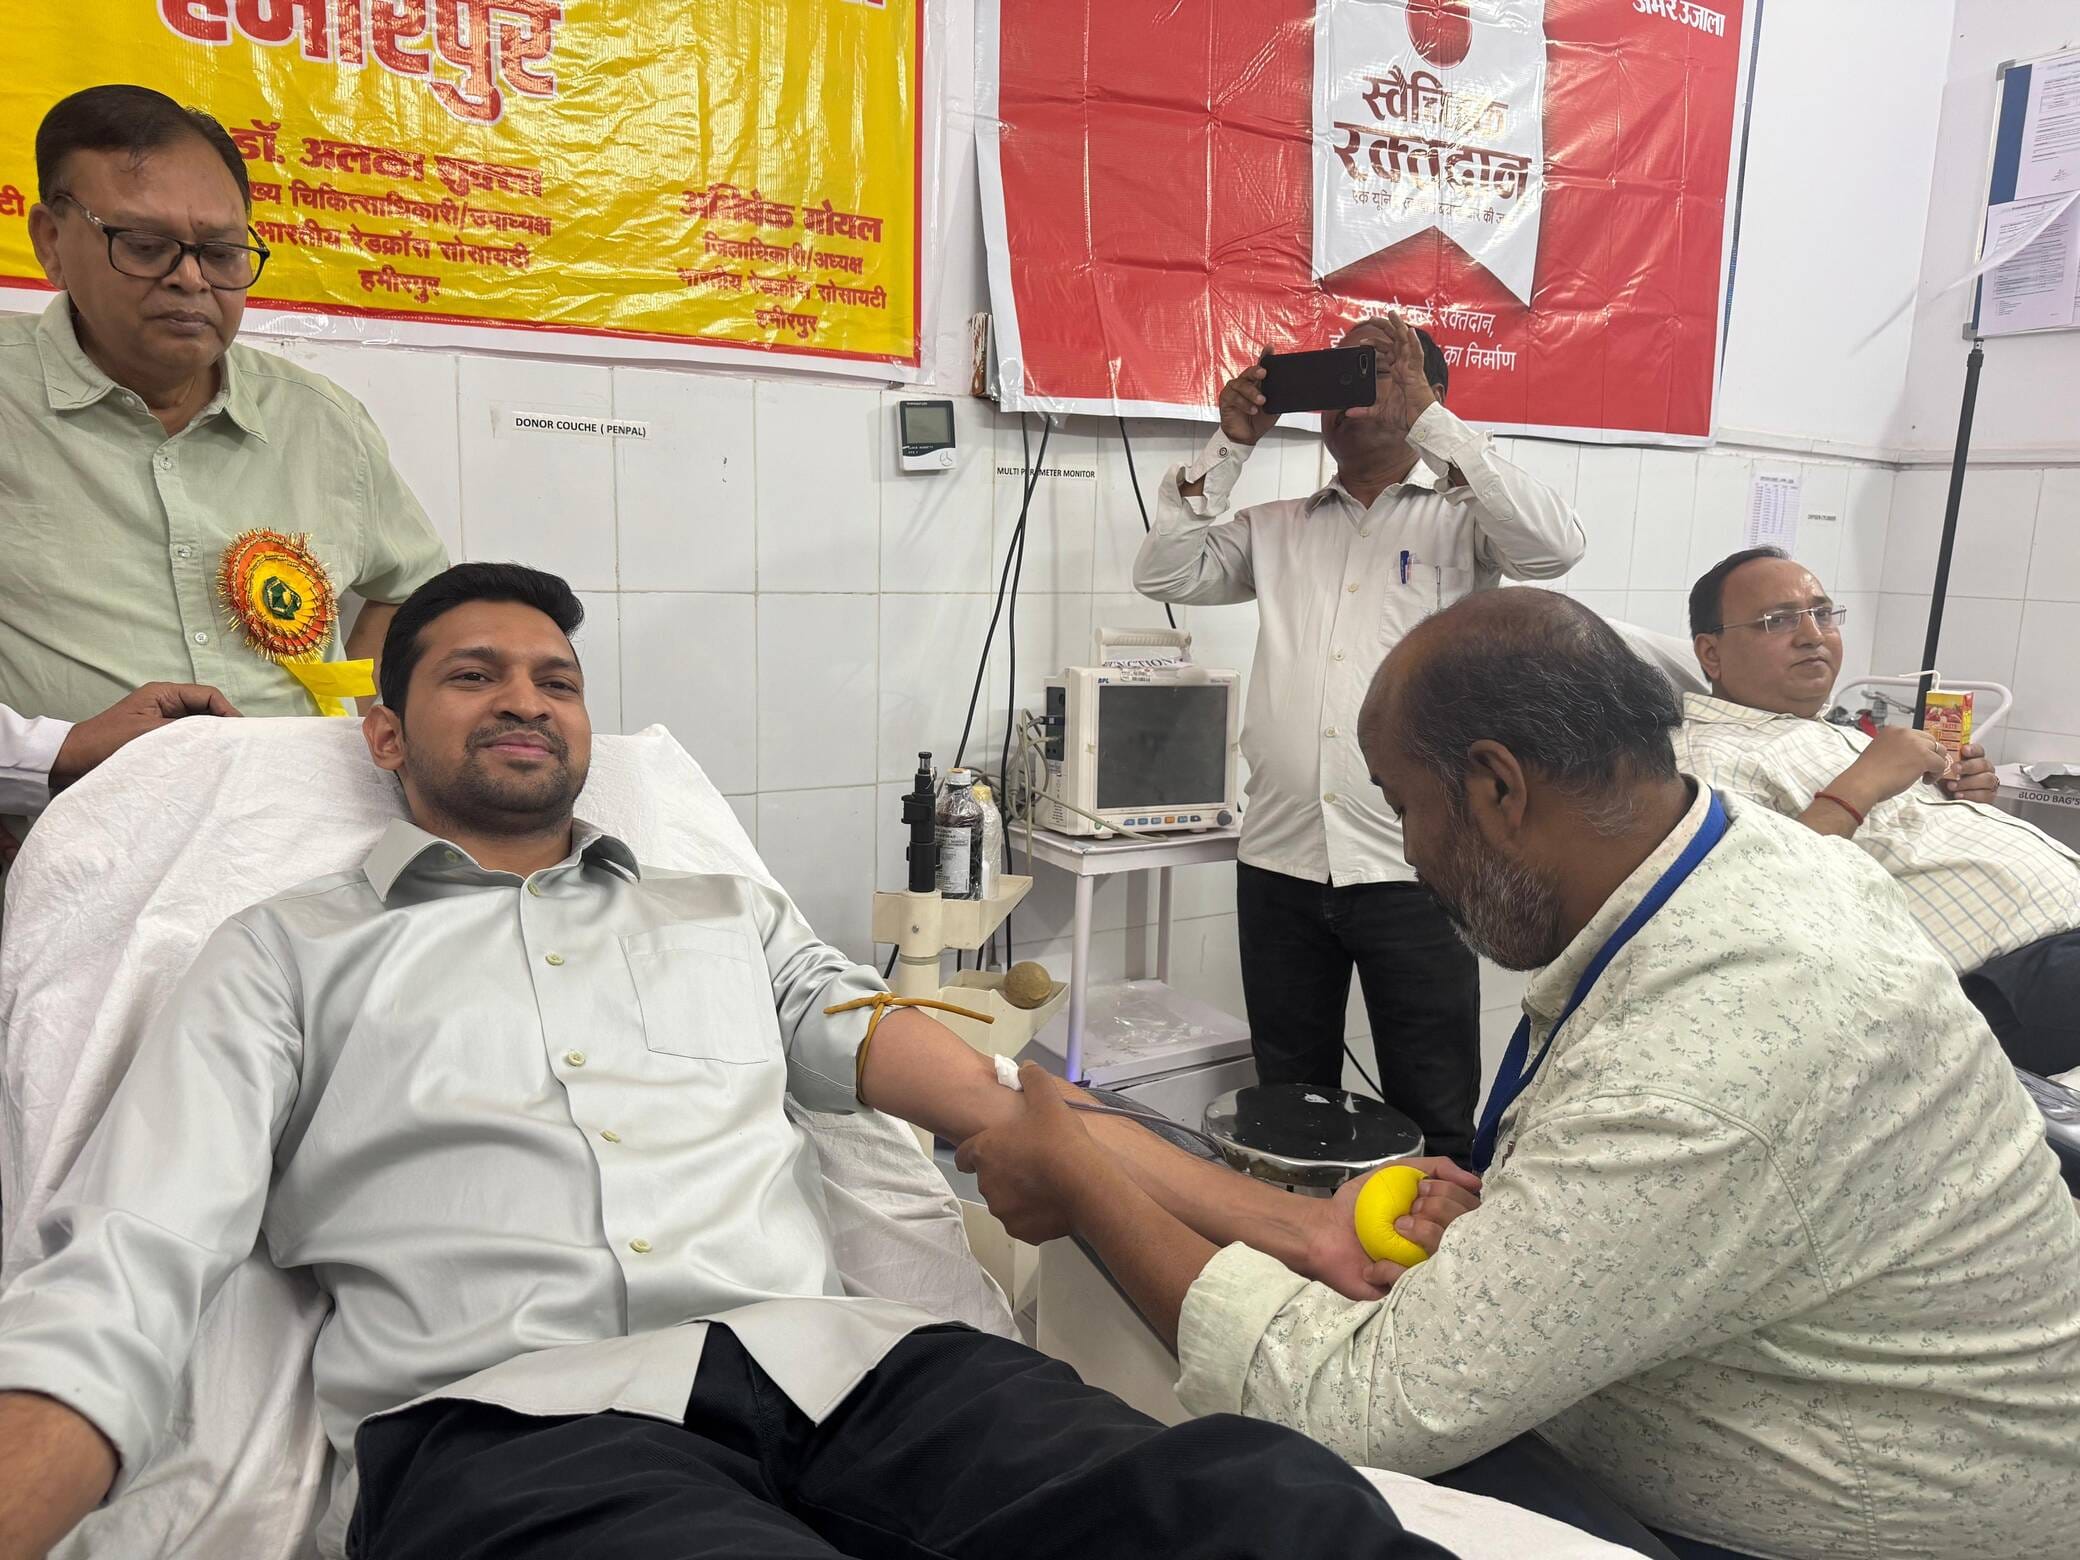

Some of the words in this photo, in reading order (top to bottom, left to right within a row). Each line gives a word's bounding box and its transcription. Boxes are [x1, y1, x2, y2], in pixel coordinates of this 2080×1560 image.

[1679, 0, 1726, 37] उजाला
[229, 119, 286, 164] डॉ.
[299, 137, 426, 181] अलका
[1333, 121, 1533, 201] रक्तदान
[250, 181, 282, 205] ख्य
[1372, 189, 1392, 212] यूनि
[1483, 206, 1495, 225] की
[801, 198, 884, 243] गोयल
[254, 218, 342, 250] भारतीय
[437, 234, 531, 268] सोसायटी
[358, 263, 442, 304] हमीरपुर
[816, 278, 888, 309] सोसायटी
[1439, 306, 1496, 338] रक्तदान,
[1444, 345, 1464, 367] का
[1465, 341, 1517, 372] निर्माण
[515, 418, 553, 430] DONOR
[556, 421, 598, 433] COUCHE
[606, 425, 647, 438] PENPAL)
[997, 467, 1020, 476] MULTI
[1021, 468, 1062, 477] PRMETER
[1063, 470, 1096, 478] MONITOR
[2018, 792, 2050, 802] BLOOD
[2052, 794, 2080, 806] BAG'S
